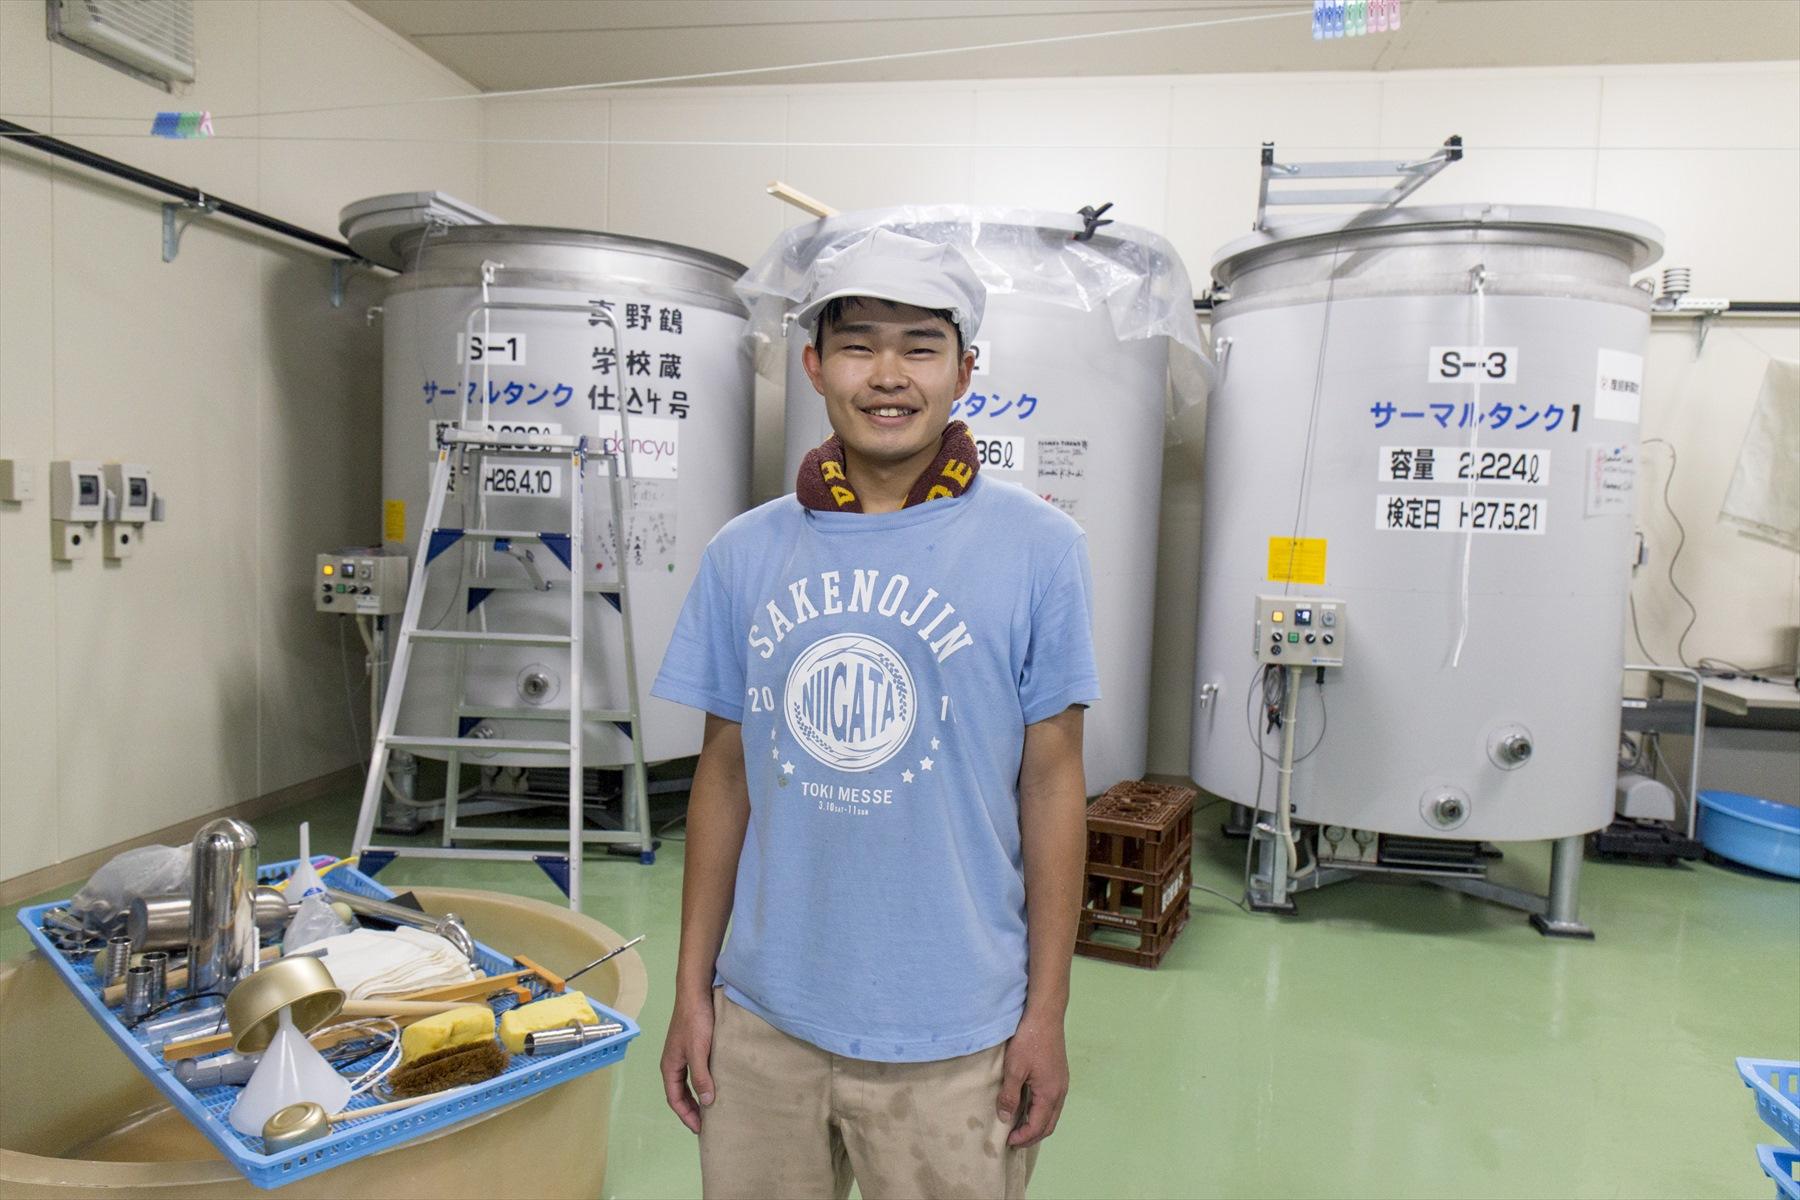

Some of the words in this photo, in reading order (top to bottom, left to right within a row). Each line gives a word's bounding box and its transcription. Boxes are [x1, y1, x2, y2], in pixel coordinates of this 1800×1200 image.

[592, 346, 682, 380] 学校蔵
[1440, 351, 1507, 378] S-3
[1390, 449, 1435, 480] 容量
[1387, 497, 1441, 529] 検定日
[748, 568, 974, 664] SAKENOJIN
[748, 686, 775, 713] 20
[801, 661, 896, 744] NIIGATA
[801, 782, 833, 799] TOKI
[838, 786, 893, 804] MESSE
